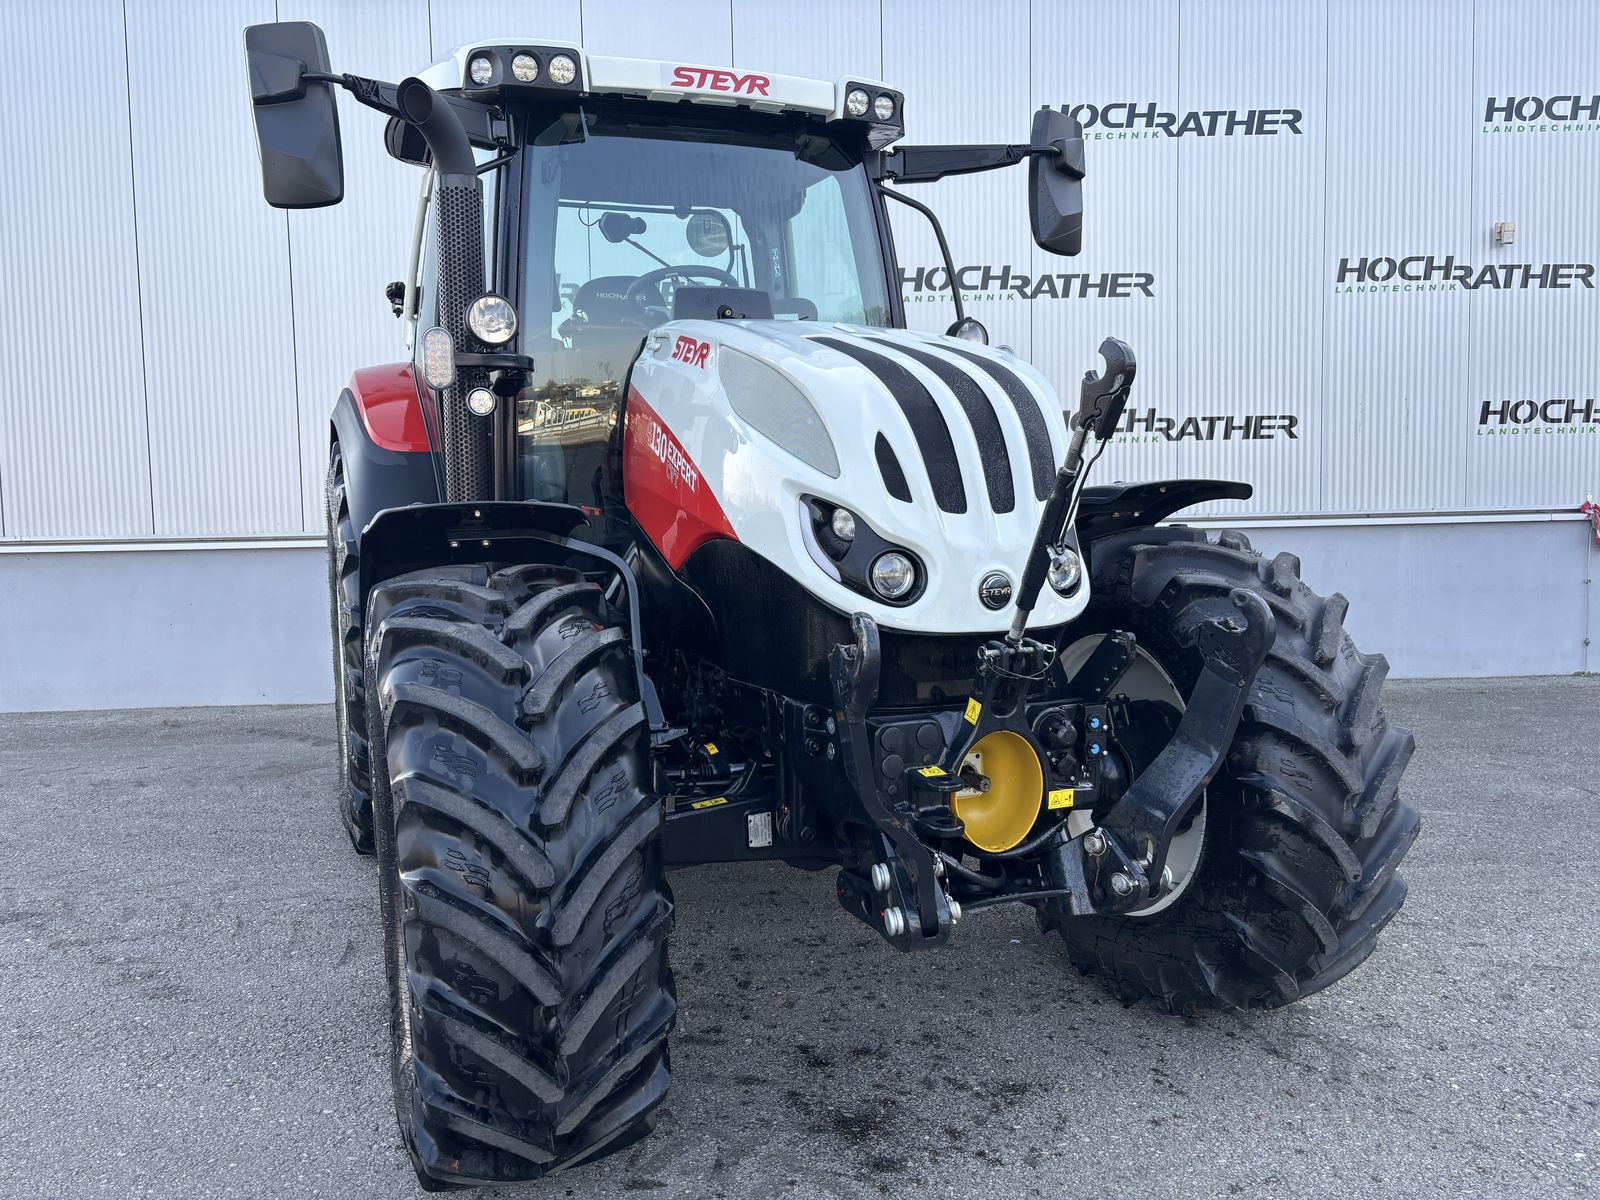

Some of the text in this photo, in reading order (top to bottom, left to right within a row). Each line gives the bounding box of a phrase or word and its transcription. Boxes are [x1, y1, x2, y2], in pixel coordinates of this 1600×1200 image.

[670, 66, 770, 97] STEYR
[1041, 102, 1303, 138] OCHRATHER
[1484, 95, 1600, 123] HOCH
[1083, 131, 1160, 141] TECHNIK
[897, 265, 1155, 300] HOCHRATHER
[1336, 255, 1596, 290] HOCHRATHER
[903, 293, 1015, 303] ANDTCHNIK
[1334, 283, 1457, 294] LANDTECHNIK
[671, 335, 711, 369] STEYR
[1062, 407, 1300, 442] HRATHER
[1479, 398, 1600, 425] HOCH
[1477, 426, 1597, 436] LANDTECHNIK
[667, 440, 698, 493] EXPERT
[981, 586, 1011, 598] STEYR
